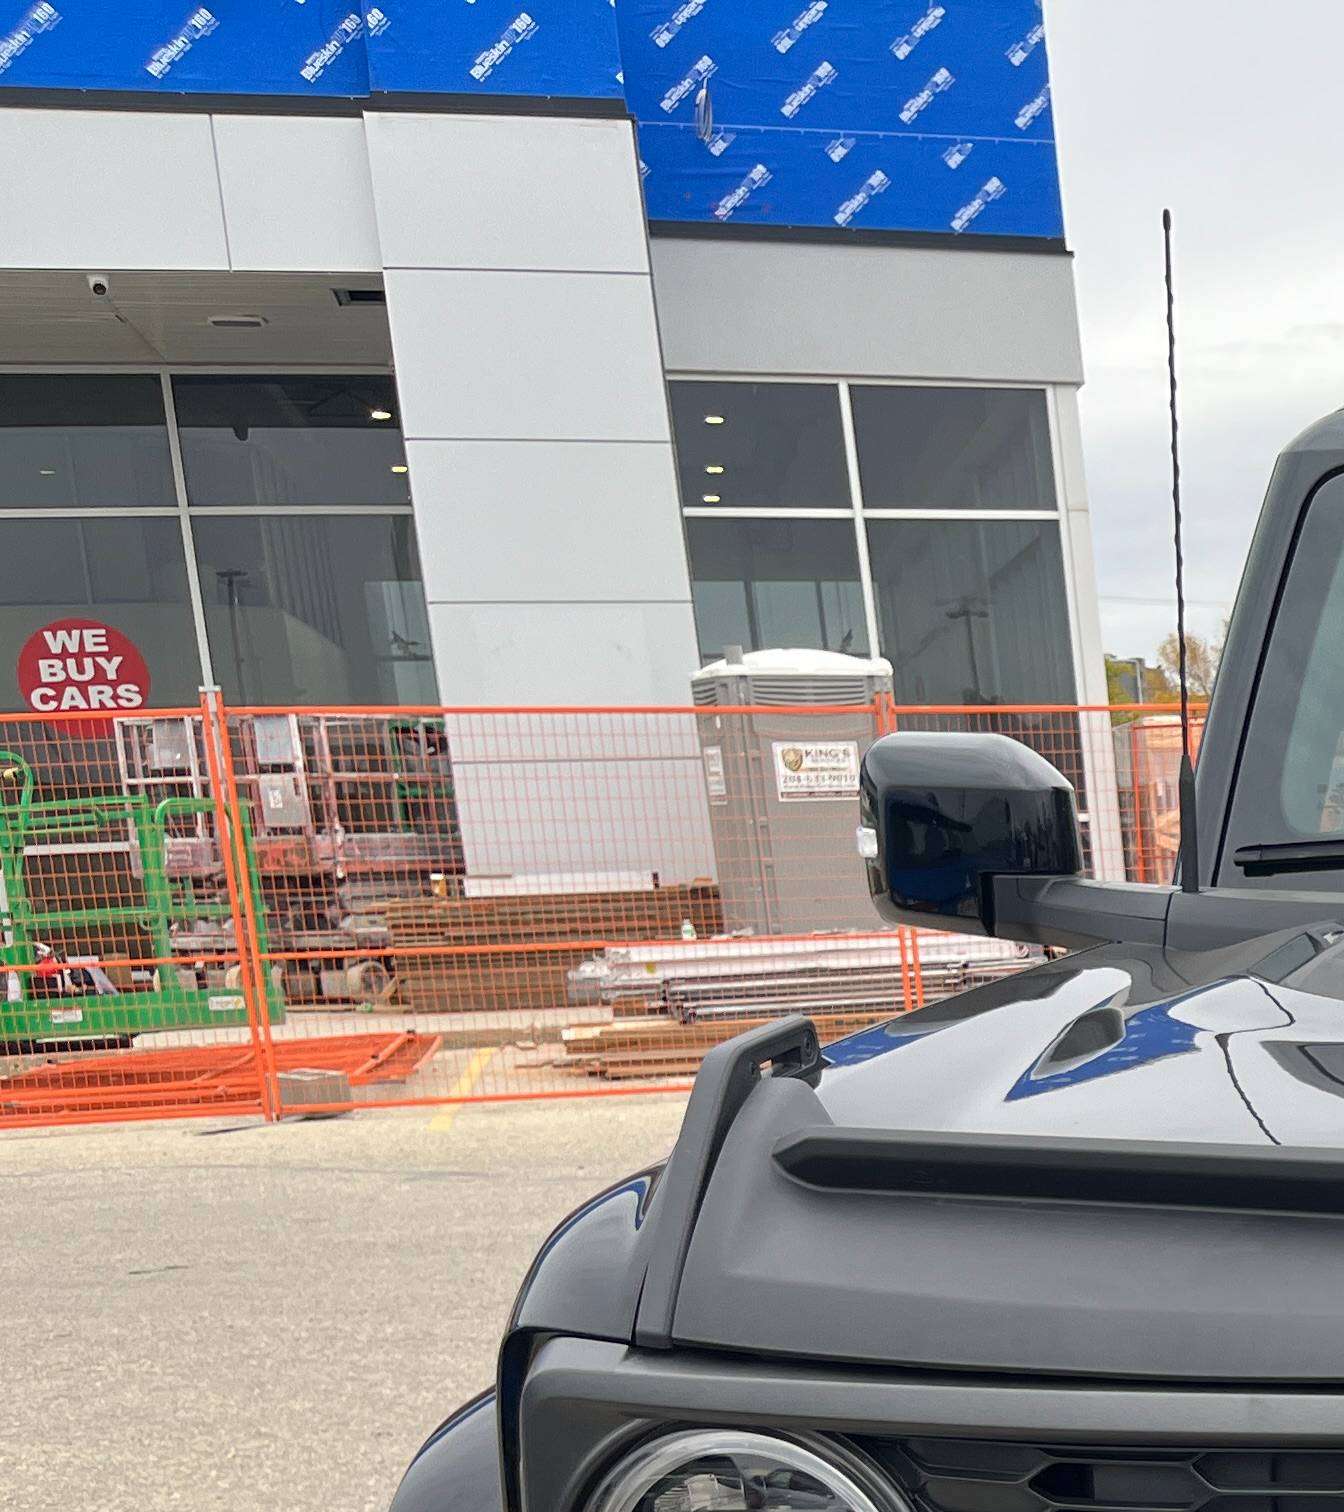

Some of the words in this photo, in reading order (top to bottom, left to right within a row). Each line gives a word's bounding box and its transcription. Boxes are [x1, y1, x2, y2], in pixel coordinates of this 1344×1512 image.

[43, 629, 109, 654] WE
[38, 656, 123, 683] BUY
[31, 684, 143, 711] CARS
